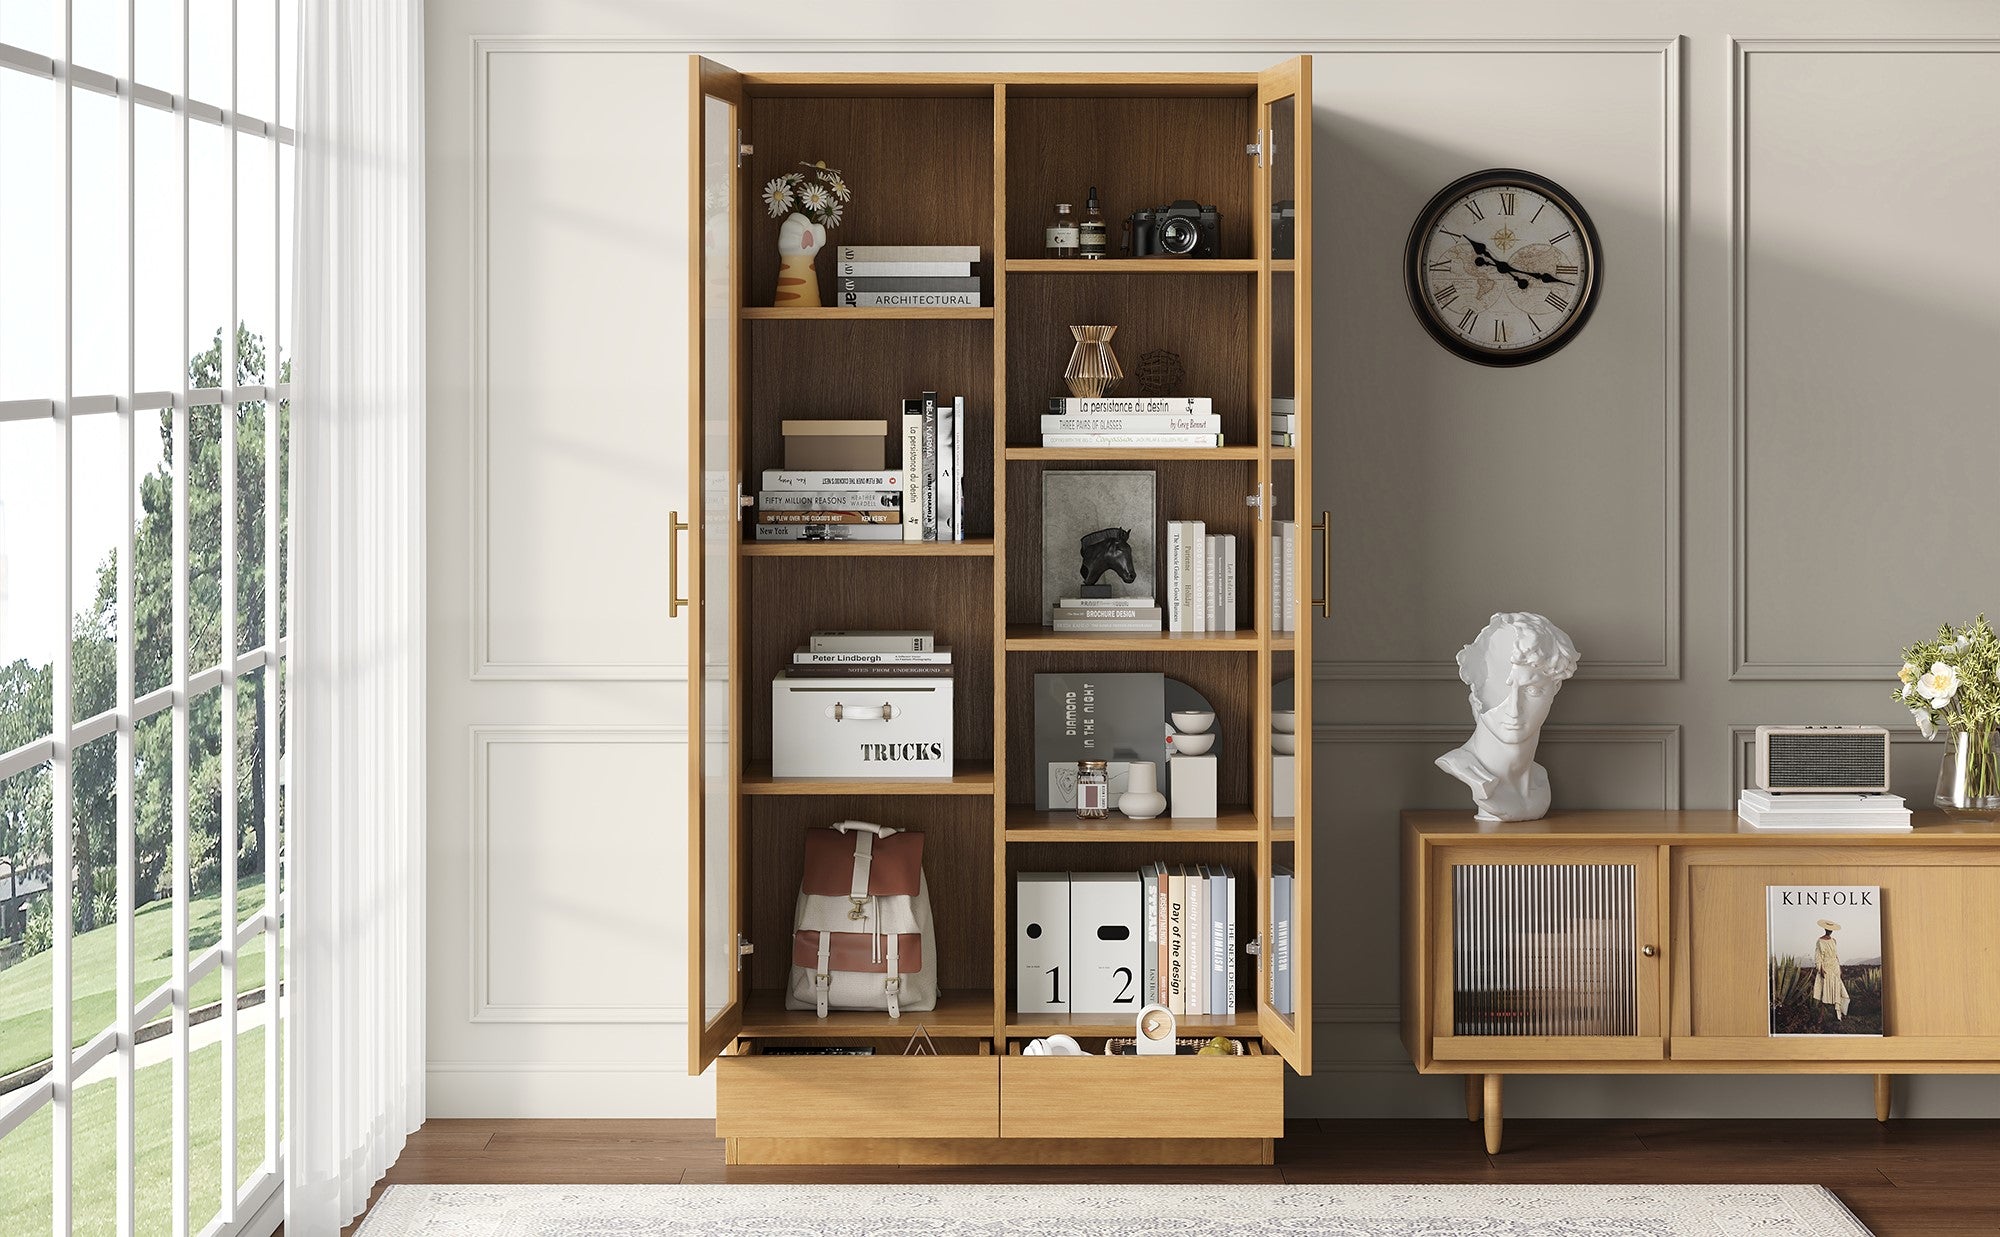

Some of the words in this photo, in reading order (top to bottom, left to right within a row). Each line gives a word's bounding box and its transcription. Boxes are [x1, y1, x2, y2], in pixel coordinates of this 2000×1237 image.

[875, 295, 972, 305] ARCHITECTURAL
[1080, 399, 1088, 413] La
[1090, 399, 1133, 415] persistance
[1135, 399, 1145, 413] du
[1147, 398, 1169, 413] destin
[910, 426, 919, 434] La
[1059, 419, 1075, 430] THREE
[1092, 419, 1099, 430] OF
[1100, 419, 1123, 430] GLASSES
[908, 435, 919, 472] persistance
[910, 473, 919, 482] du
[765, 496, 783, 505] FIFTY
[785, 496, 813, 505] MILLION
[815, 496, 847, 505] REASONS
[910, 484, 919, 503] destin
[774, 527, 789, 535] York
[1086, 610, 1115, 618] BROCHURE
[1116, 610, 1136, 618] DESIGN
[812, 654, 835, 662] Peter
[837, 654, 882, 663] Lindbergh
[1083, 683, 1094, 713] NIGHT
[1066, 691, 1077, 736] DIAMOND
[1083, 719, 1094, 736] THE
[860, 743, 942, 761] TRUCKS
[1083, 739, 1094, 748] IN
[1189, 884, 1198, 921] simplicity
[1782, 891, 1873, 906] KINFOLK
[1171, 902, 1181, 923] Day
[1172, 925, 1181, 938] of
[1172, 940, 1181, 957] the
[1214, 921, 1224, 972] MINIMALISM
[1189, 941, 1198, 981] everything
[1046, 966, 1066, 1004] 1
[1112, 966, 1135, 1004] 2
[1171, 959, 1181, 995] design
